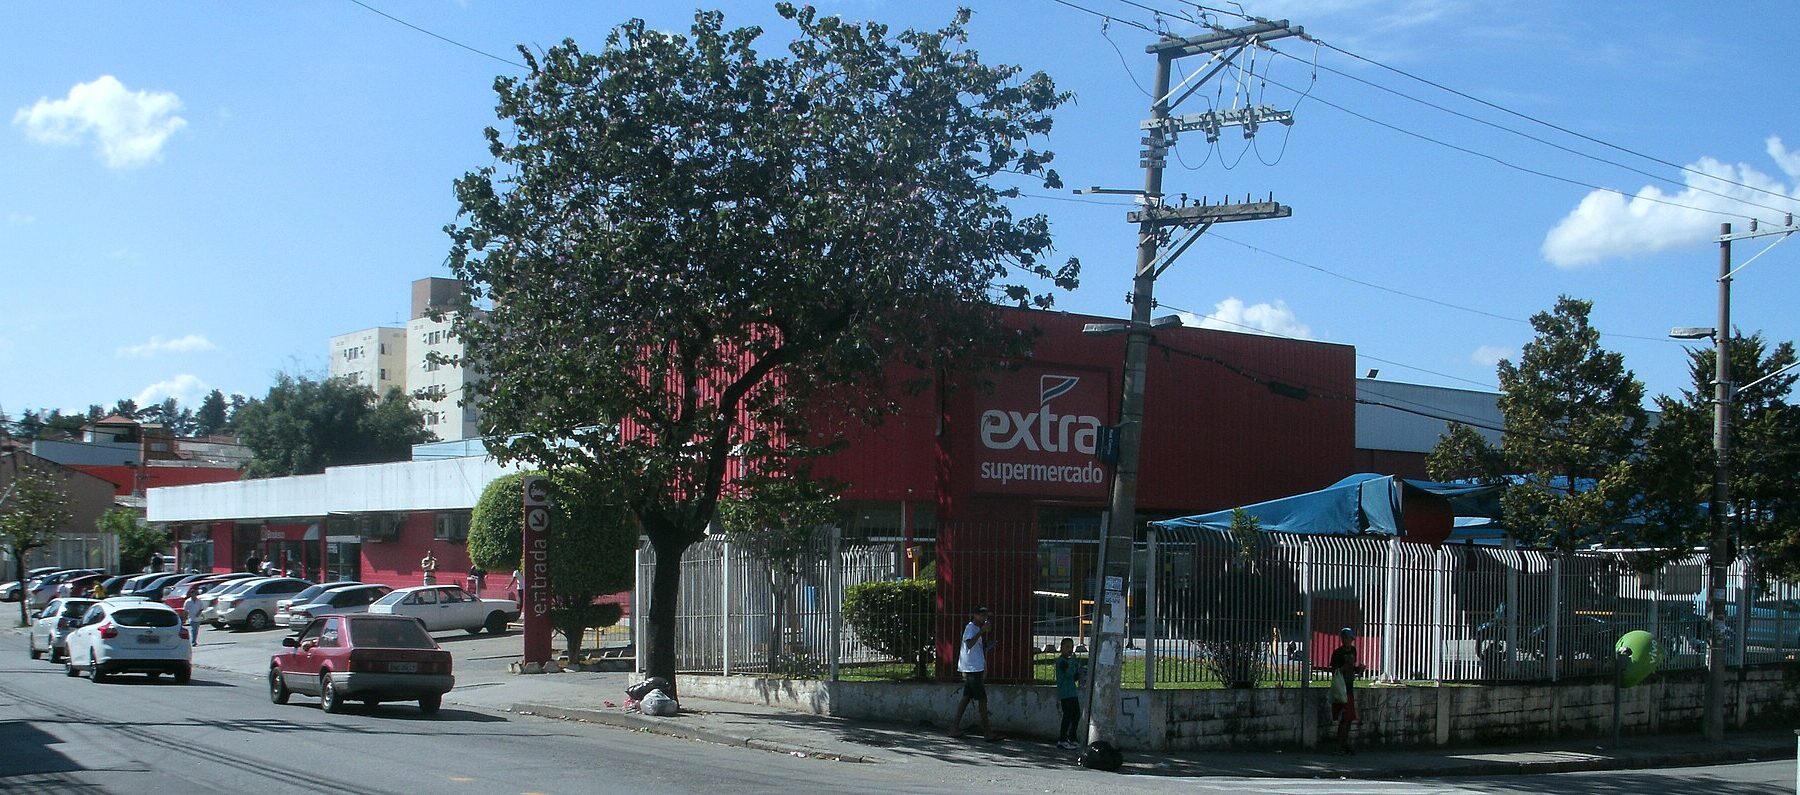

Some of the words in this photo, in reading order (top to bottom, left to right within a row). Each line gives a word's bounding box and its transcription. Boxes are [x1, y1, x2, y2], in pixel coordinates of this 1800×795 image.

[981, 403, 1101, 454] extra
[981, 461, 1104, 485] supermercado
[528, 538, 548, 615] entrada
[1649, 640, 1658, 664] vivo
